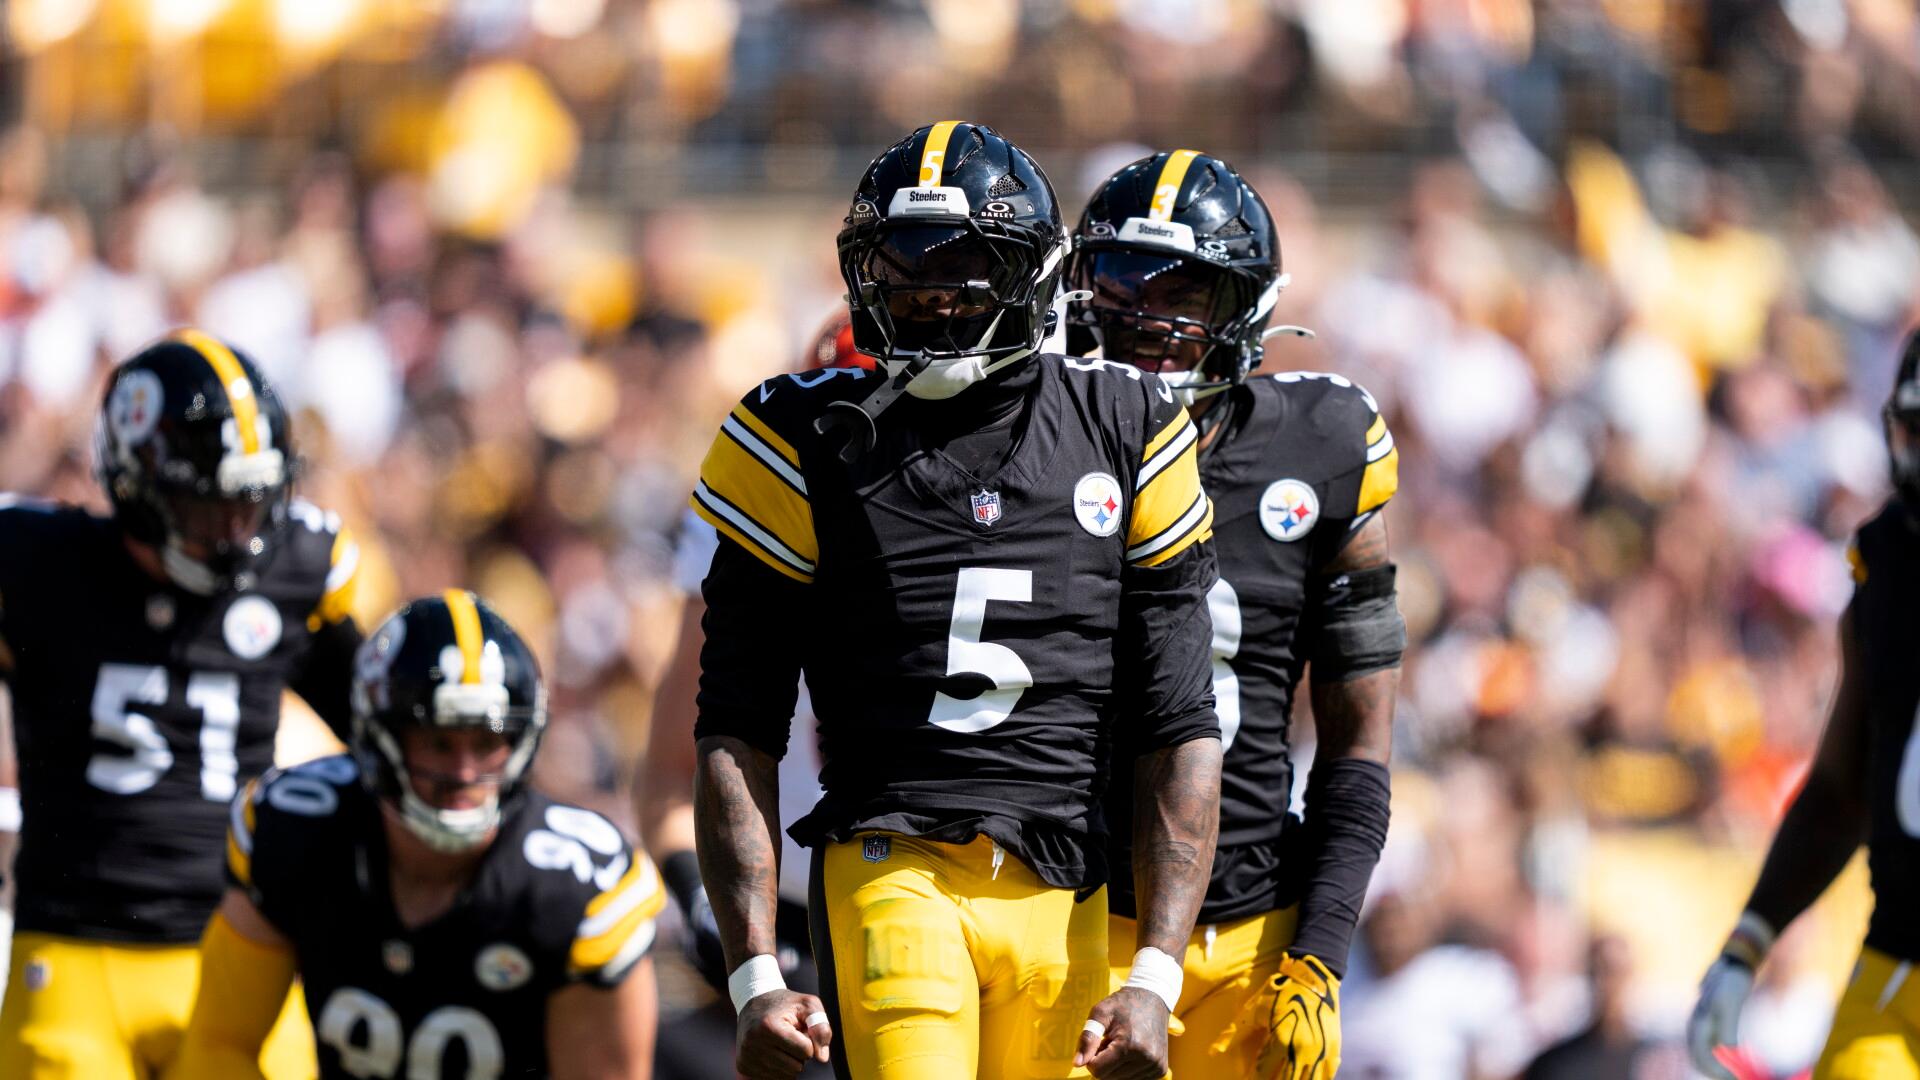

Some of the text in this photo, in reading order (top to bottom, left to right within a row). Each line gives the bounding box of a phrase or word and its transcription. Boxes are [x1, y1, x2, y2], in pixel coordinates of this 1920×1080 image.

[920, 150, 944, 188] 5
[909, 190, 947, 202] Steelers
[1149, 183, 1179, 222] 3
[980, 211, 1015, 220] OAKLEY
[1137, 223, 1175, 238] Steelers
[976, 505, 998, 521] NFL
[1079, 498, 1100, 508] Steelers
[928, 567, 1033, 734] 5
[86, 664, 240, 801] 51
[523, 804, 624, 884] 90
[867, 845, 886, 857] NFL
[318, 987, 505, 1080] 90
